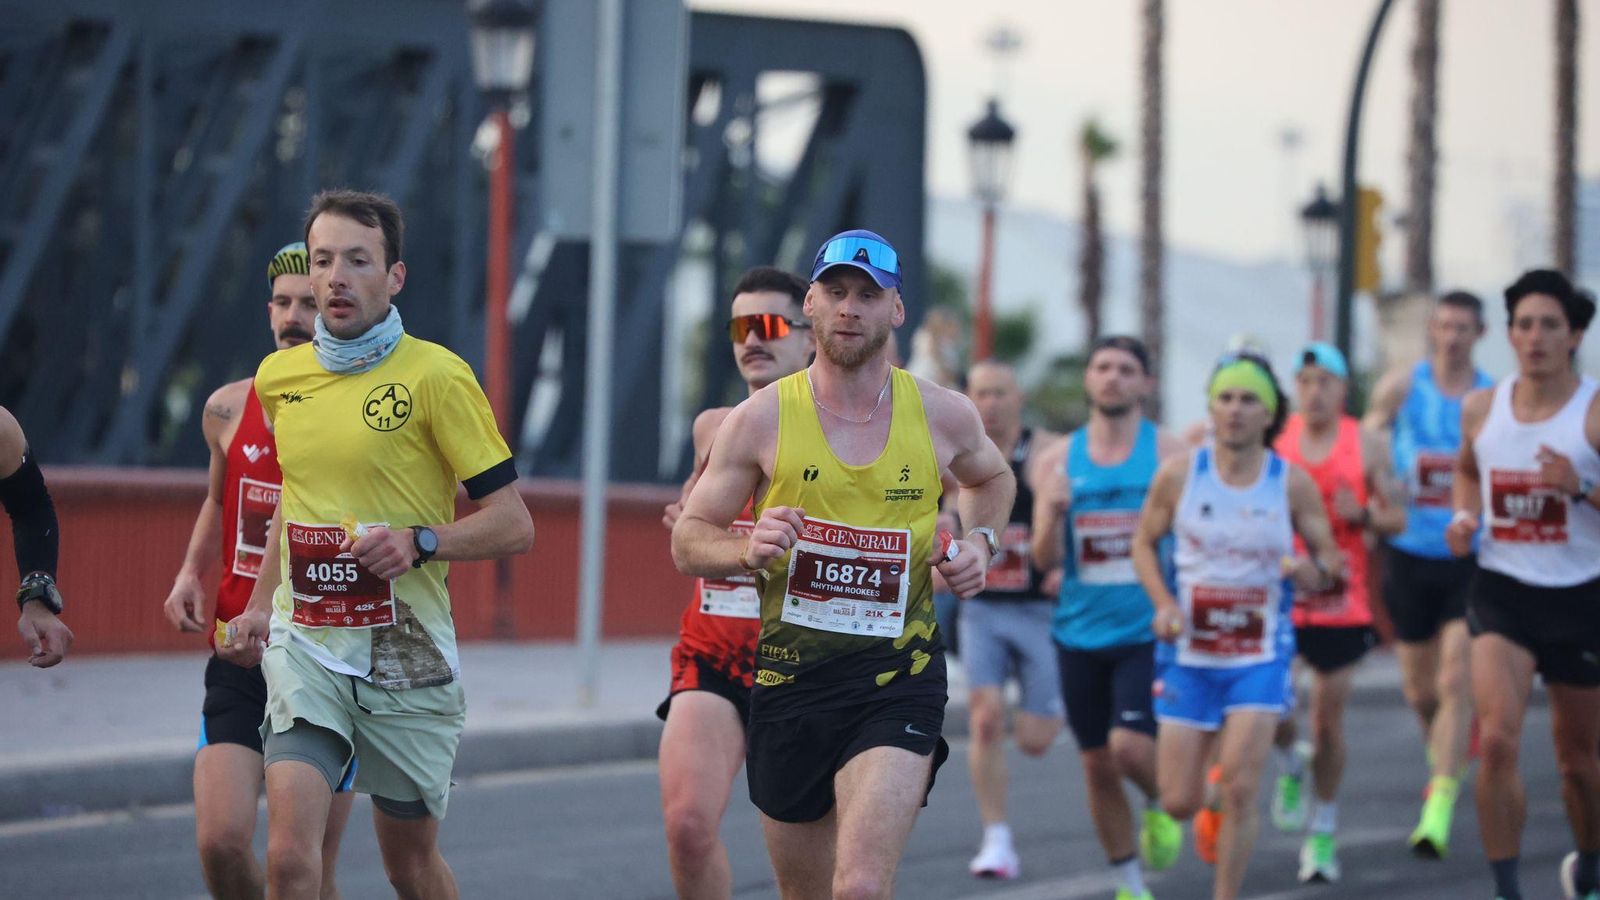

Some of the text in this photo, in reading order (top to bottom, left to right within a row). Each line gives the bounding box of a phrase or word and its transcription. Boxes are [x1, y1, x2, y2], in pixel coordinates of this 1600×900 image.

[376, 416, 391, 428] 11
[304, 530, 345, 546] GENE
[825, 528, 901, 551] GENERALI
[306, 563, 358, 582] 4055
[815, 560, 882, 588] 16874
[317, 584, 348, 592] CARLOS
[810, 581, 881, 597] RHYTHM ROOKEES
[354, 603, 375, 611] 42K
[865, 609, 884, 618] 21K
